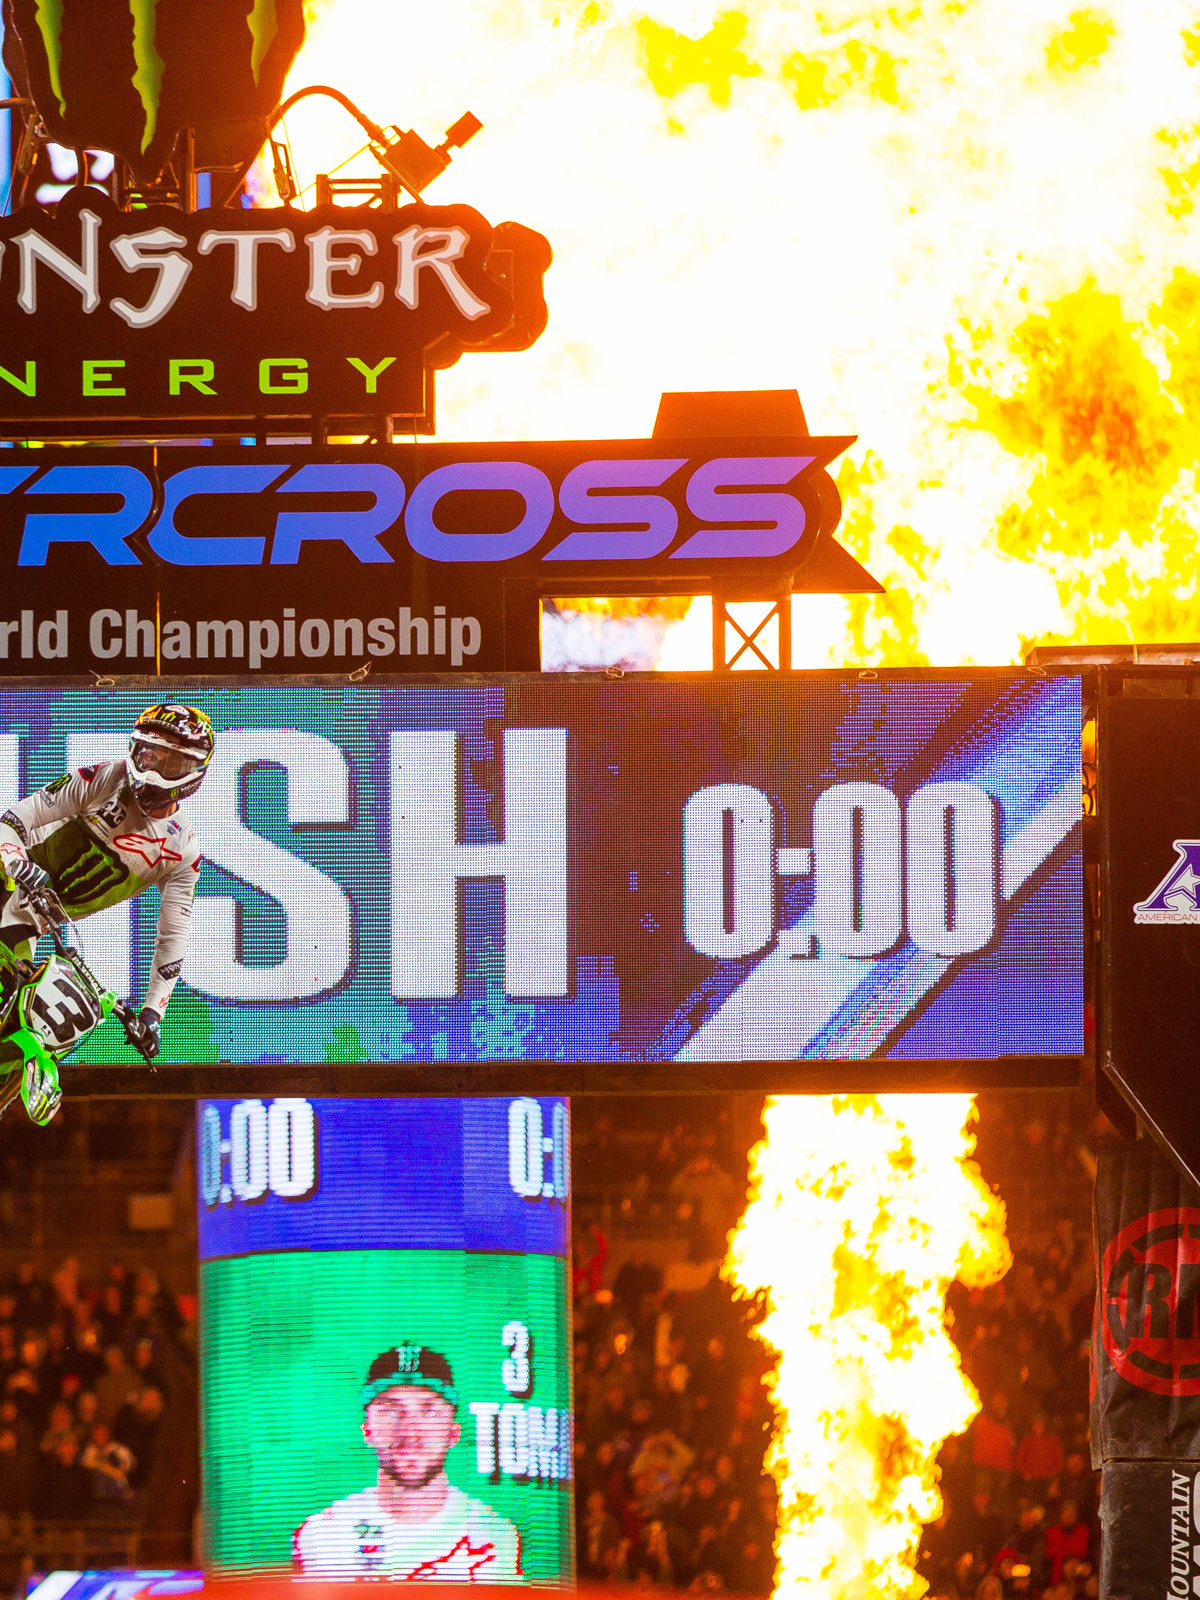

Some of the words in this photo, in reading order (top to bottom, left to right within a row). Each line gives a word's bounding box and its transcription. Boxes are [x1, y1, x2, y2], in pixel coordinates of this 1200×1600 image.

[88, 606, 482, 667] Championship
[683, 781, 997, 960] 0:00
[1138, 913, 1198, 921] AMERICAN
[31, 978, 95, 1043] 3
[502, 1321, 529, 1392] 3
